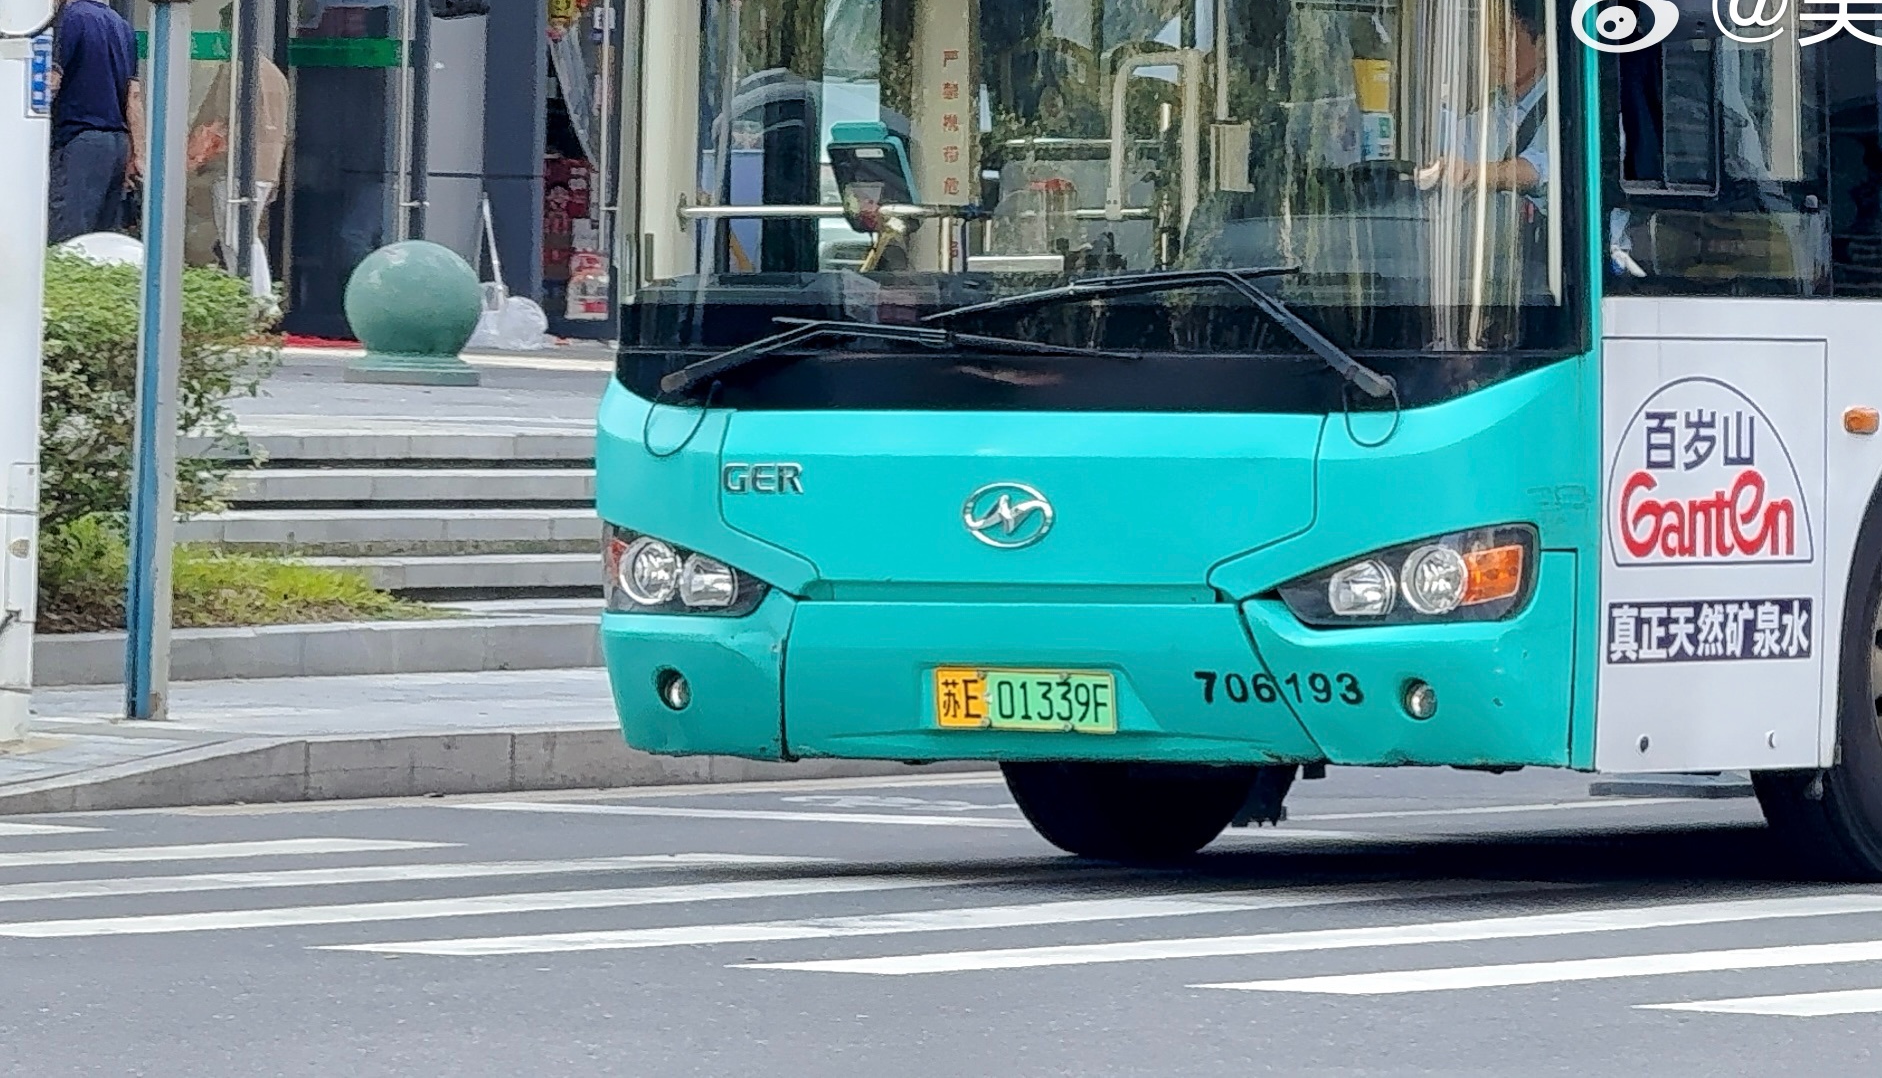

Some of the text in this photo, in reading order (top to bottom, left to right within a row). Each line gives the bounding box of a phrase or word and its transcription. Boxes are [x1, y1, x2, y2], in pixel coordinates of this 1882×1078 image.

[1644, 409, 1756, 470] 百岁山
[722, 462, 804, 495] GER
[1609, 602, 1811, 665] 真正天然矿泉水
[941, 678, 1109, 725] 苏E 01339F
[1195, 671, 1364, 707] 706193
